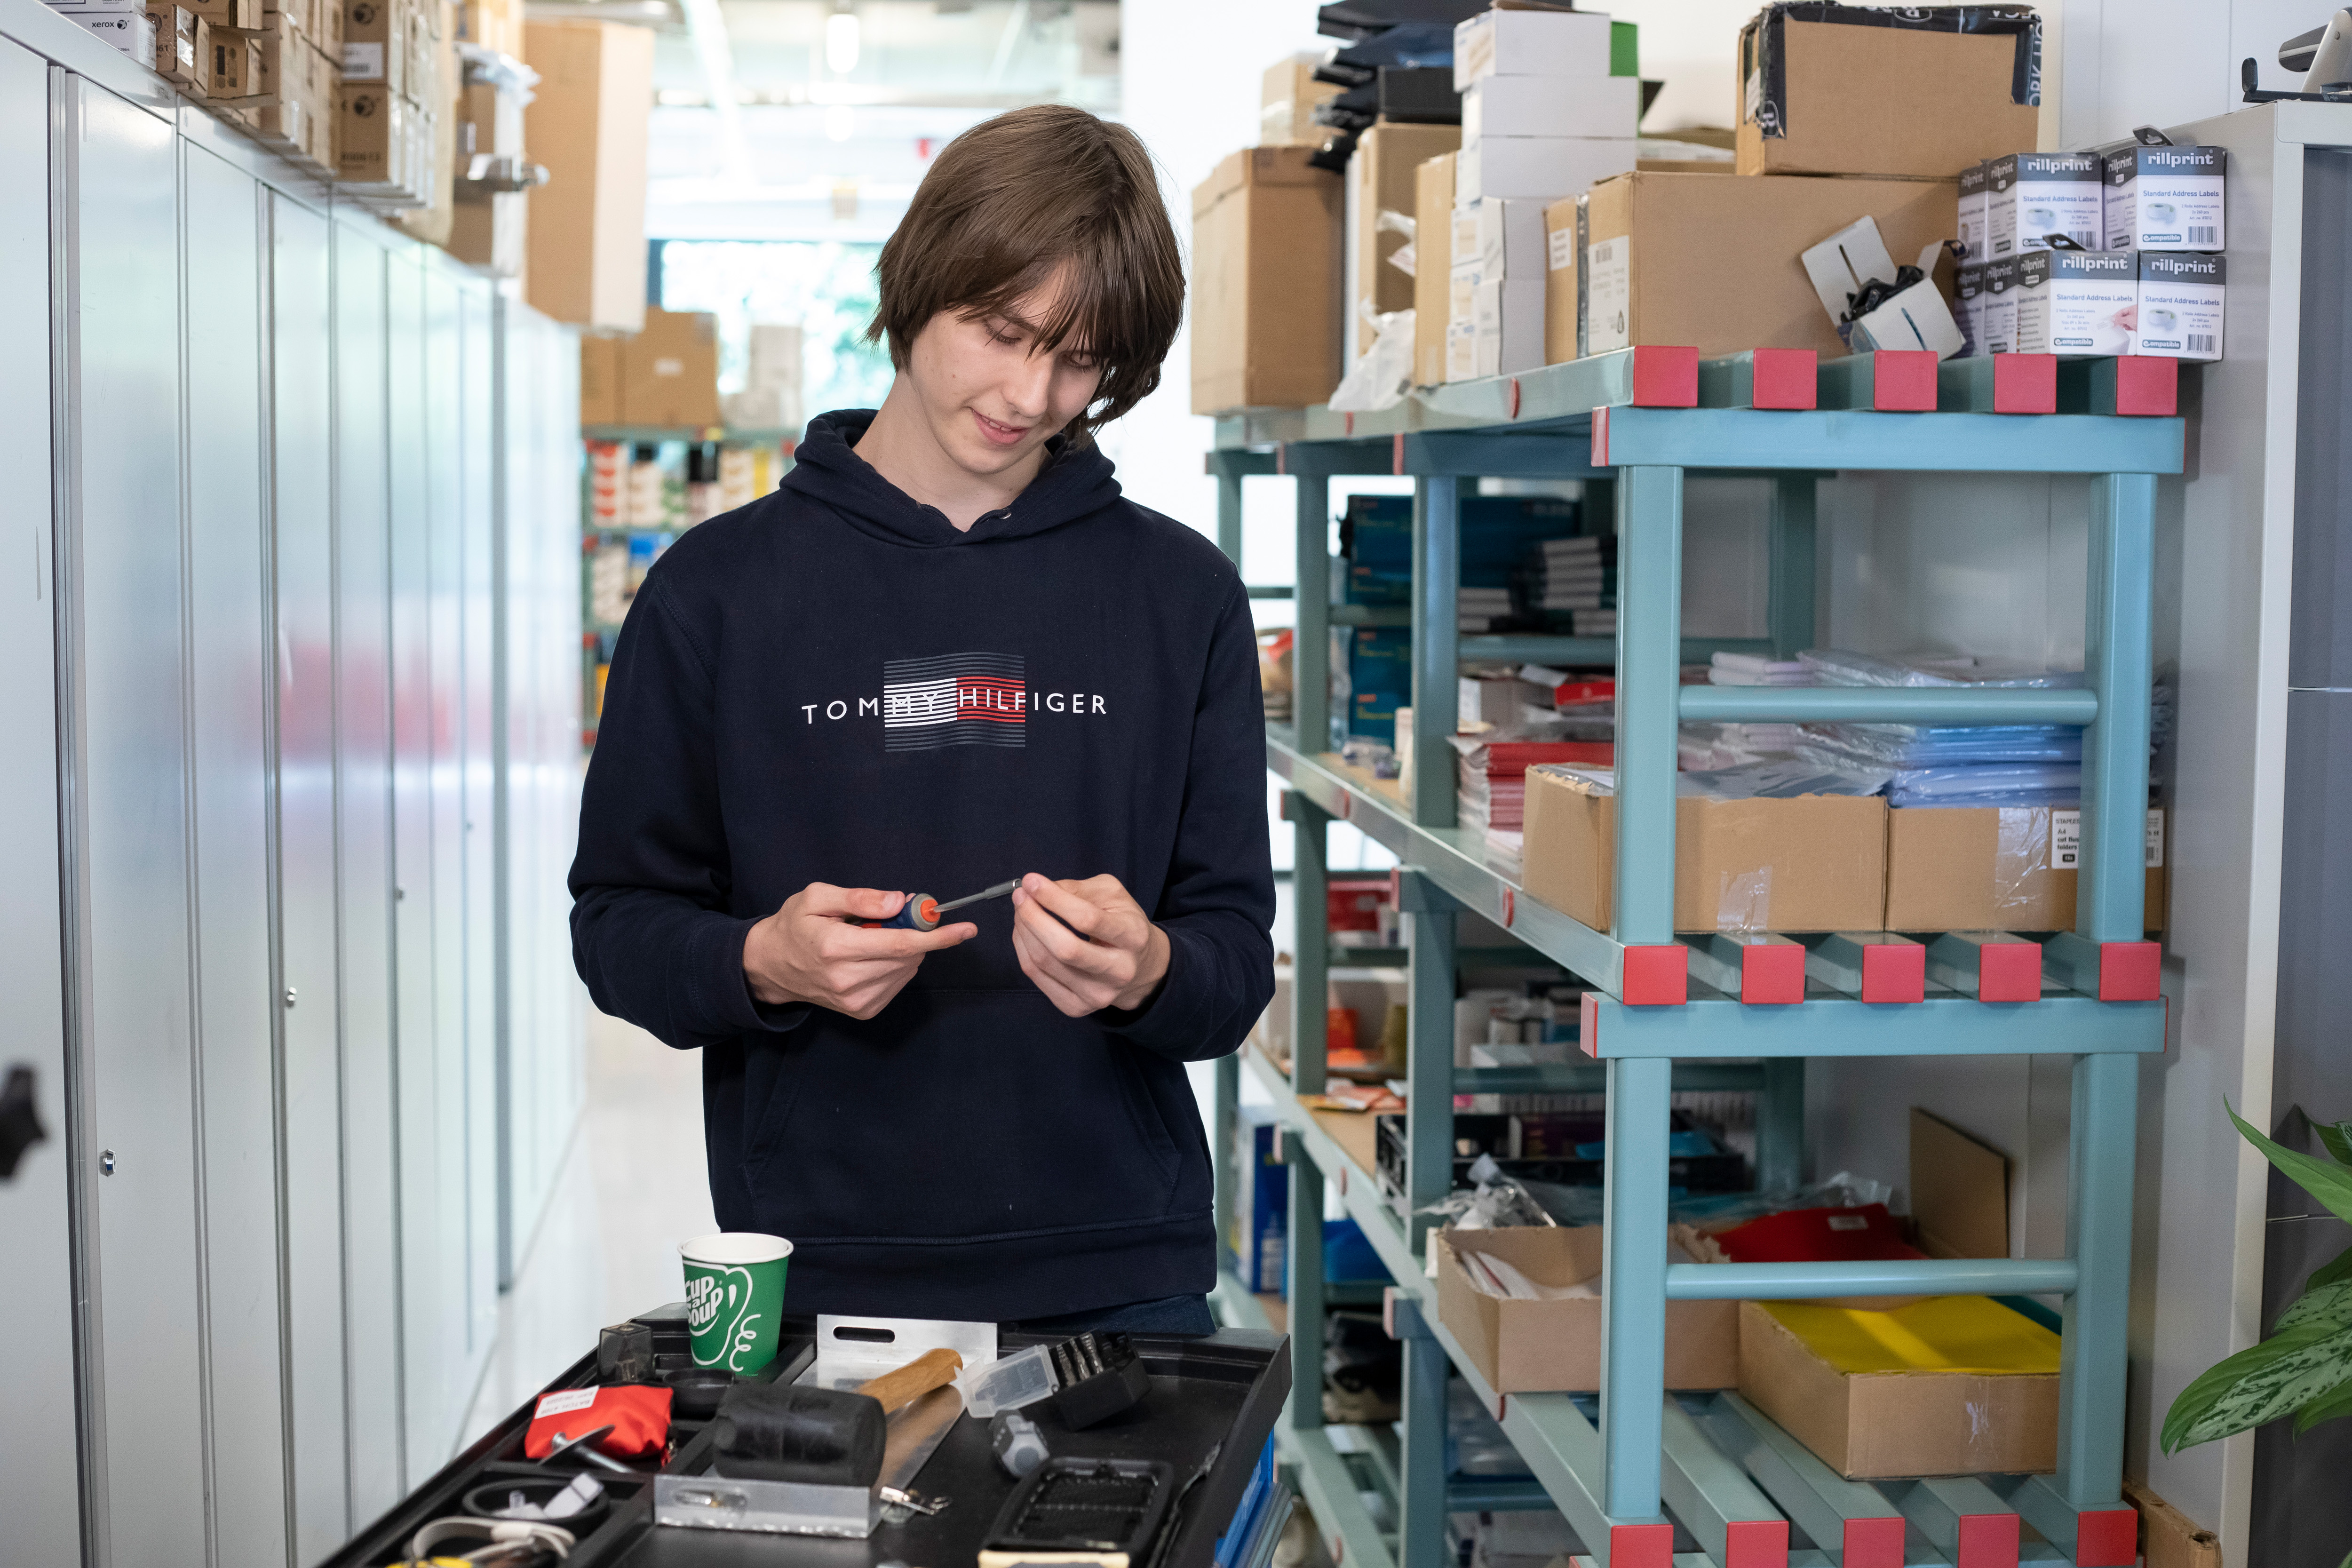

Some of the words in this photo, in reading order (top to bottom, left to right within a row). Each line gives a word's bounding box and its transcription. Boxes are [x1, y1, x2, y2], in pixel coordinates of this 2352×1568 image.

[2028, 158, 2093, 174] rillprint
[2108, 156, 2133, 173] rillprint
[2148, 152, 2214, 168] rillprint
[1991, 163, 2013, 179] rillprint
[2020, 257, 2045, 274] rillprint
[2063, 255, 2128, 272] rillprint
[2151, 258, 2216, 275] rillprint
[1986, 264, 2012, 281] rillprint
[801, 691, 938, 724] TOMMY
[960, 688, 1107, 715] HILFIGER
